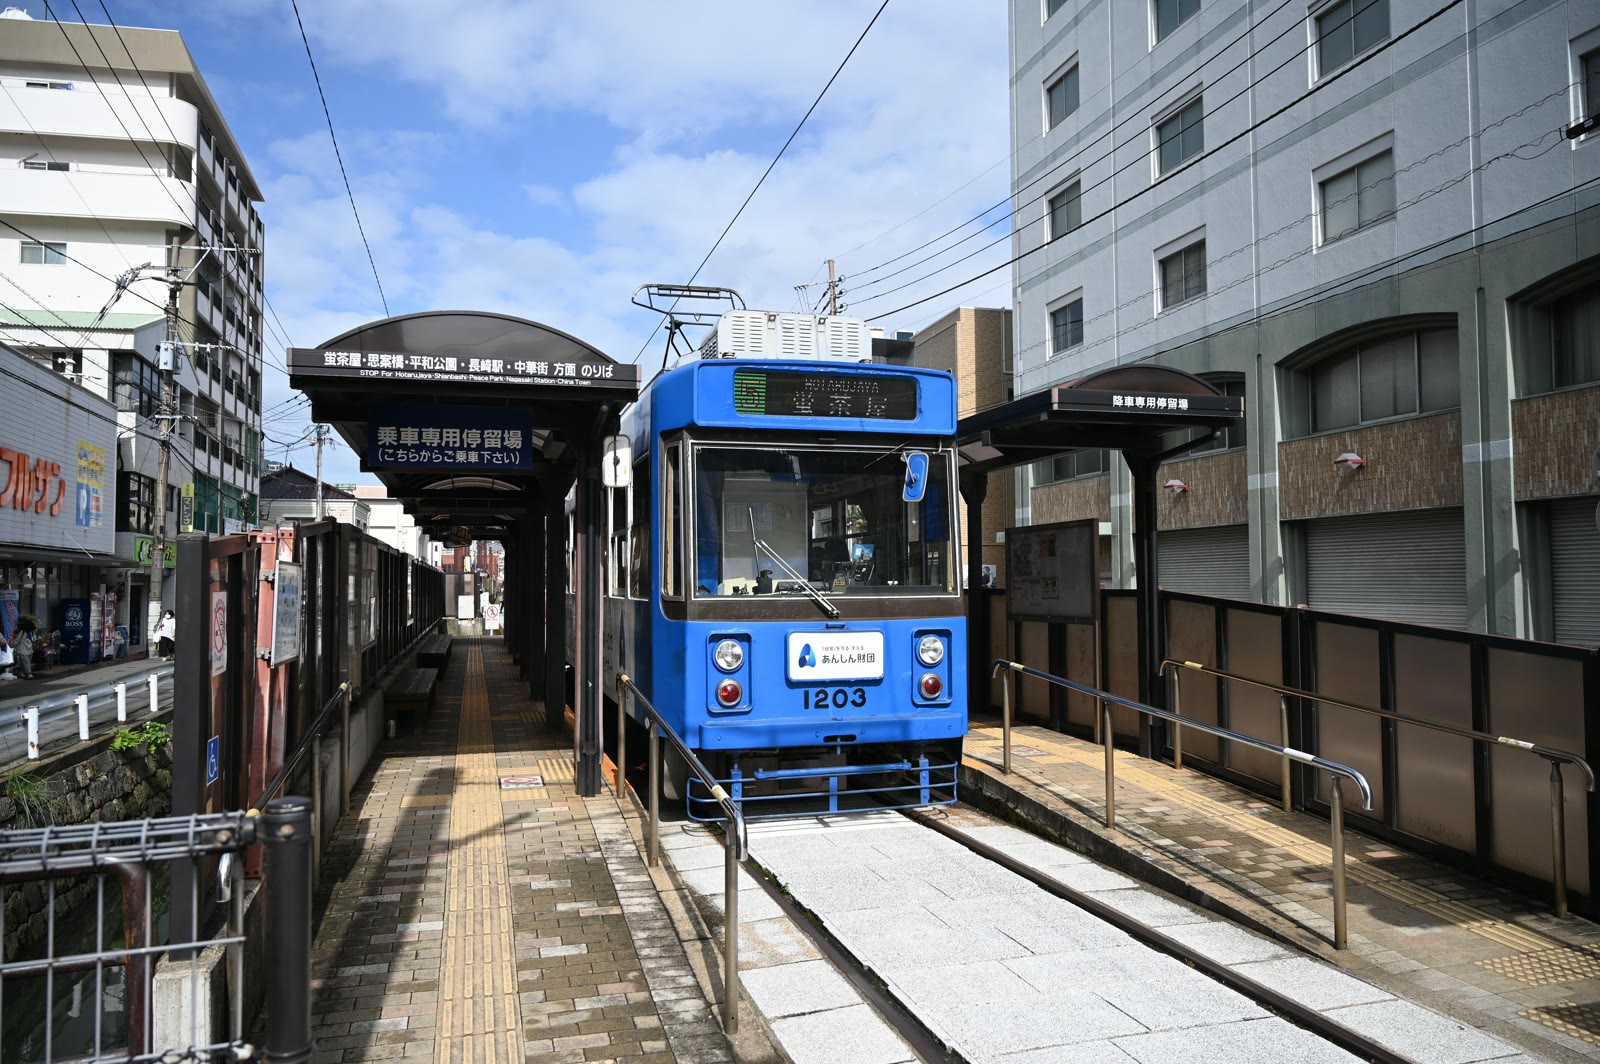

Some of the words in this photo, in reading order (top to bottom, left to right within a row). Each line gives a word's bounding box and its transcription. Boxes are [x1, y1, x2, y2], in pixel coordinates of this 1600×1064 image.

[553, 363, 577, 376] 方面
[581, 365, 614, 378] のりば
[1112, 395, 1189, 410] 降車専用停留場
[377, 426, 523, 449] 乗車専用停留場
[821, 653, 875, 664] あんしん財団
[804, 687, 866, 710] 1203
